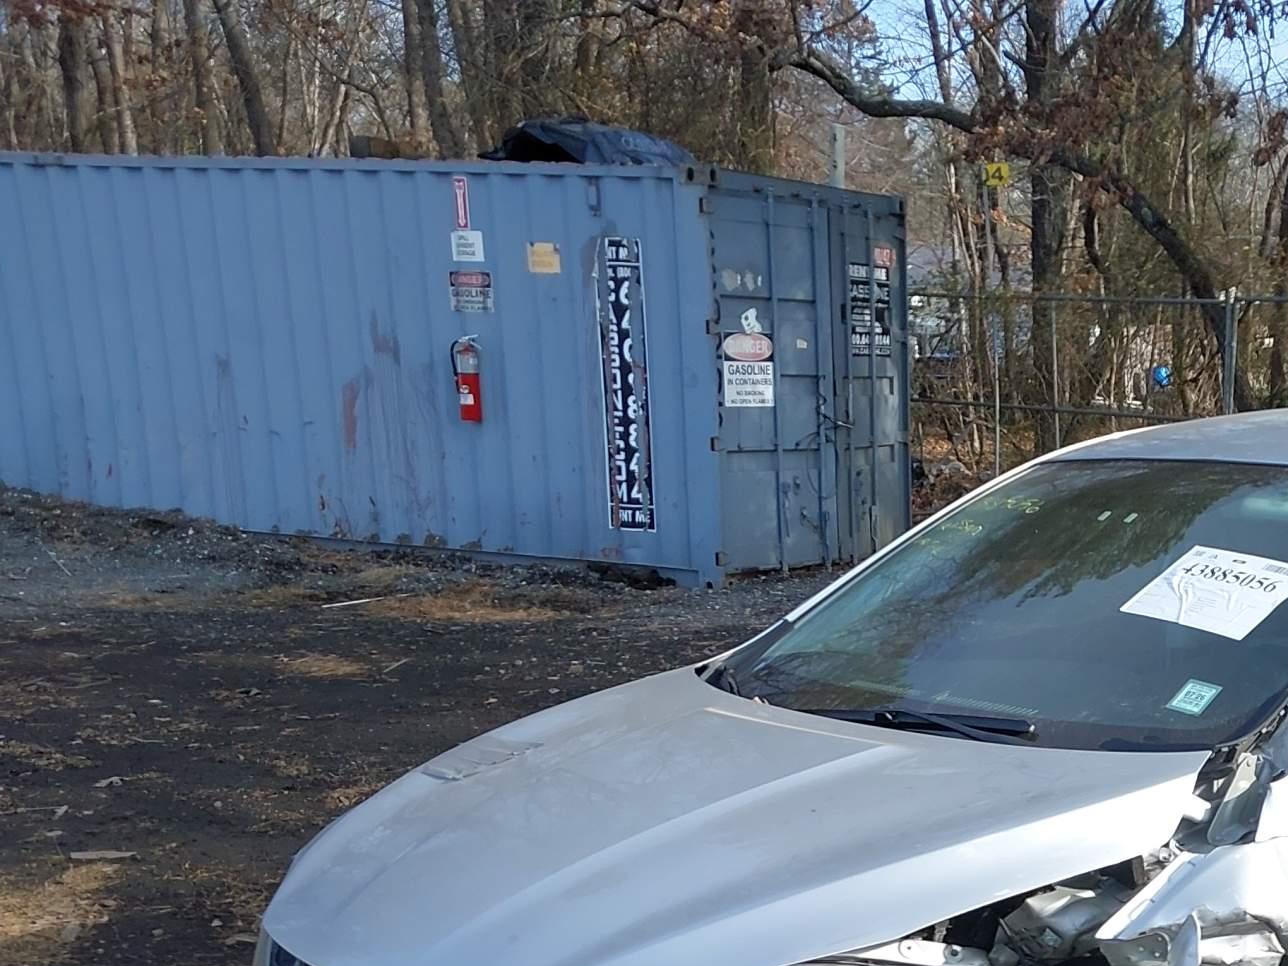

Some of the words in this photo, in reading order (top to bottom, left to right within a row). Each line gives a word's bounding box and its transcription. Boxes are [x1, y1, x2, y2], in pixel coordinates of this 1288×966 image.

[727, 364, 771, 376] GASOLINE
[727, 378, 734, 386] IN
[735, 378, 773, 386] CONTAINERS
[1183, 562, 1280, 593] 43885056
